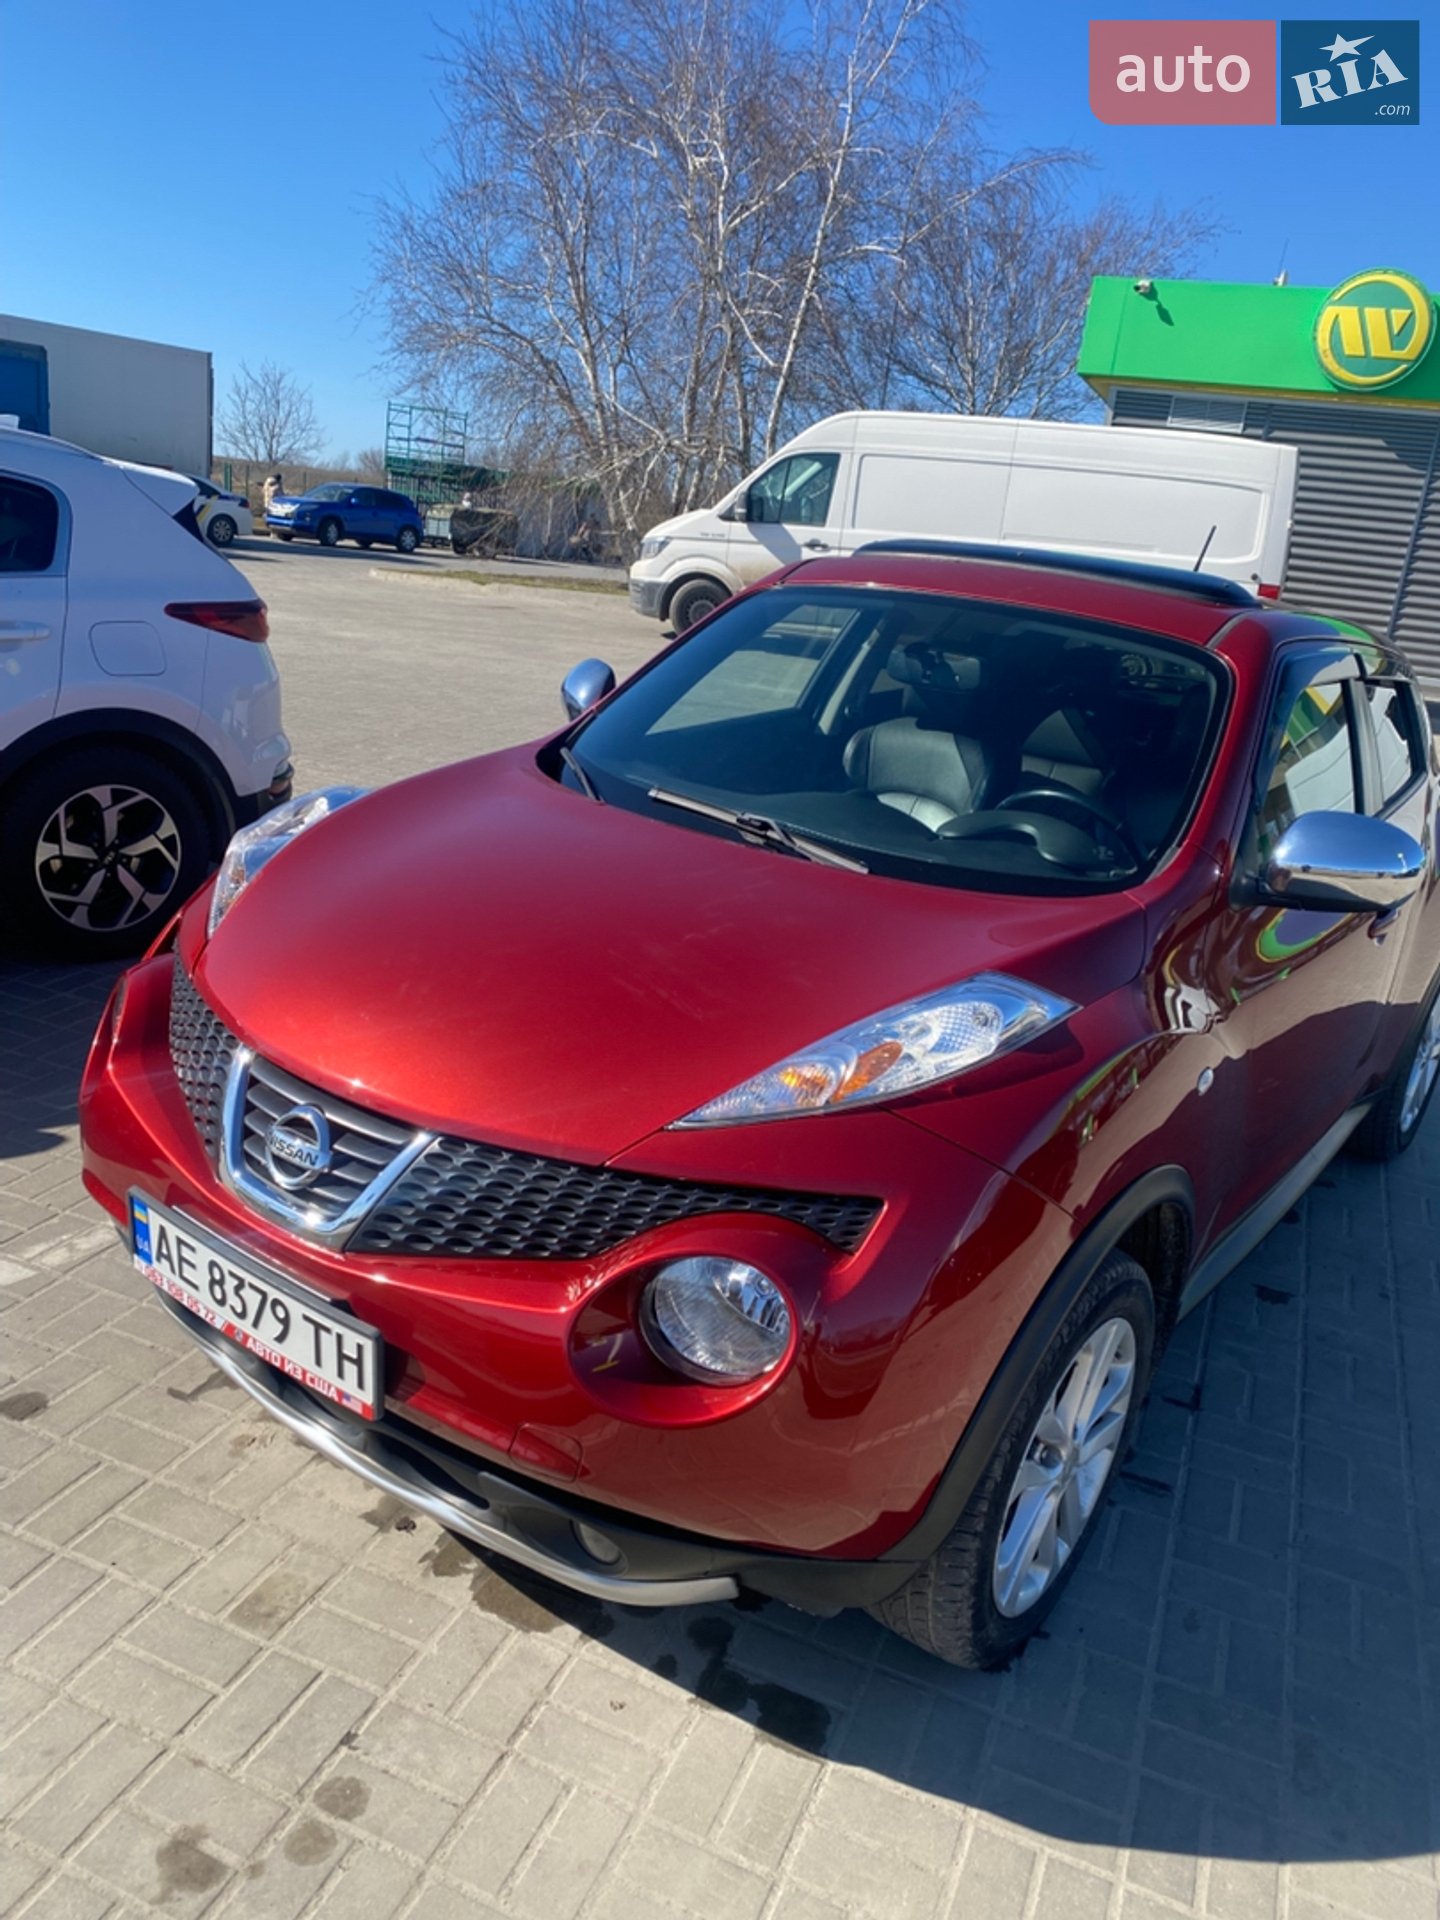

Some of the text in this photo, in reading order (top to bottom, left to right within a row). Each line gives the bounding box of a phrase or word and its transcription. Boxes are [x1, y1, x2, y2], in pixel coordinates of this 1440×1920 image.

[268, 1131, 320, 1167] NISSAN
[155, 1224, 367, 1392] AE 8379 TH
[246, 1334, 339, 1403] АВТО ИЗ США
